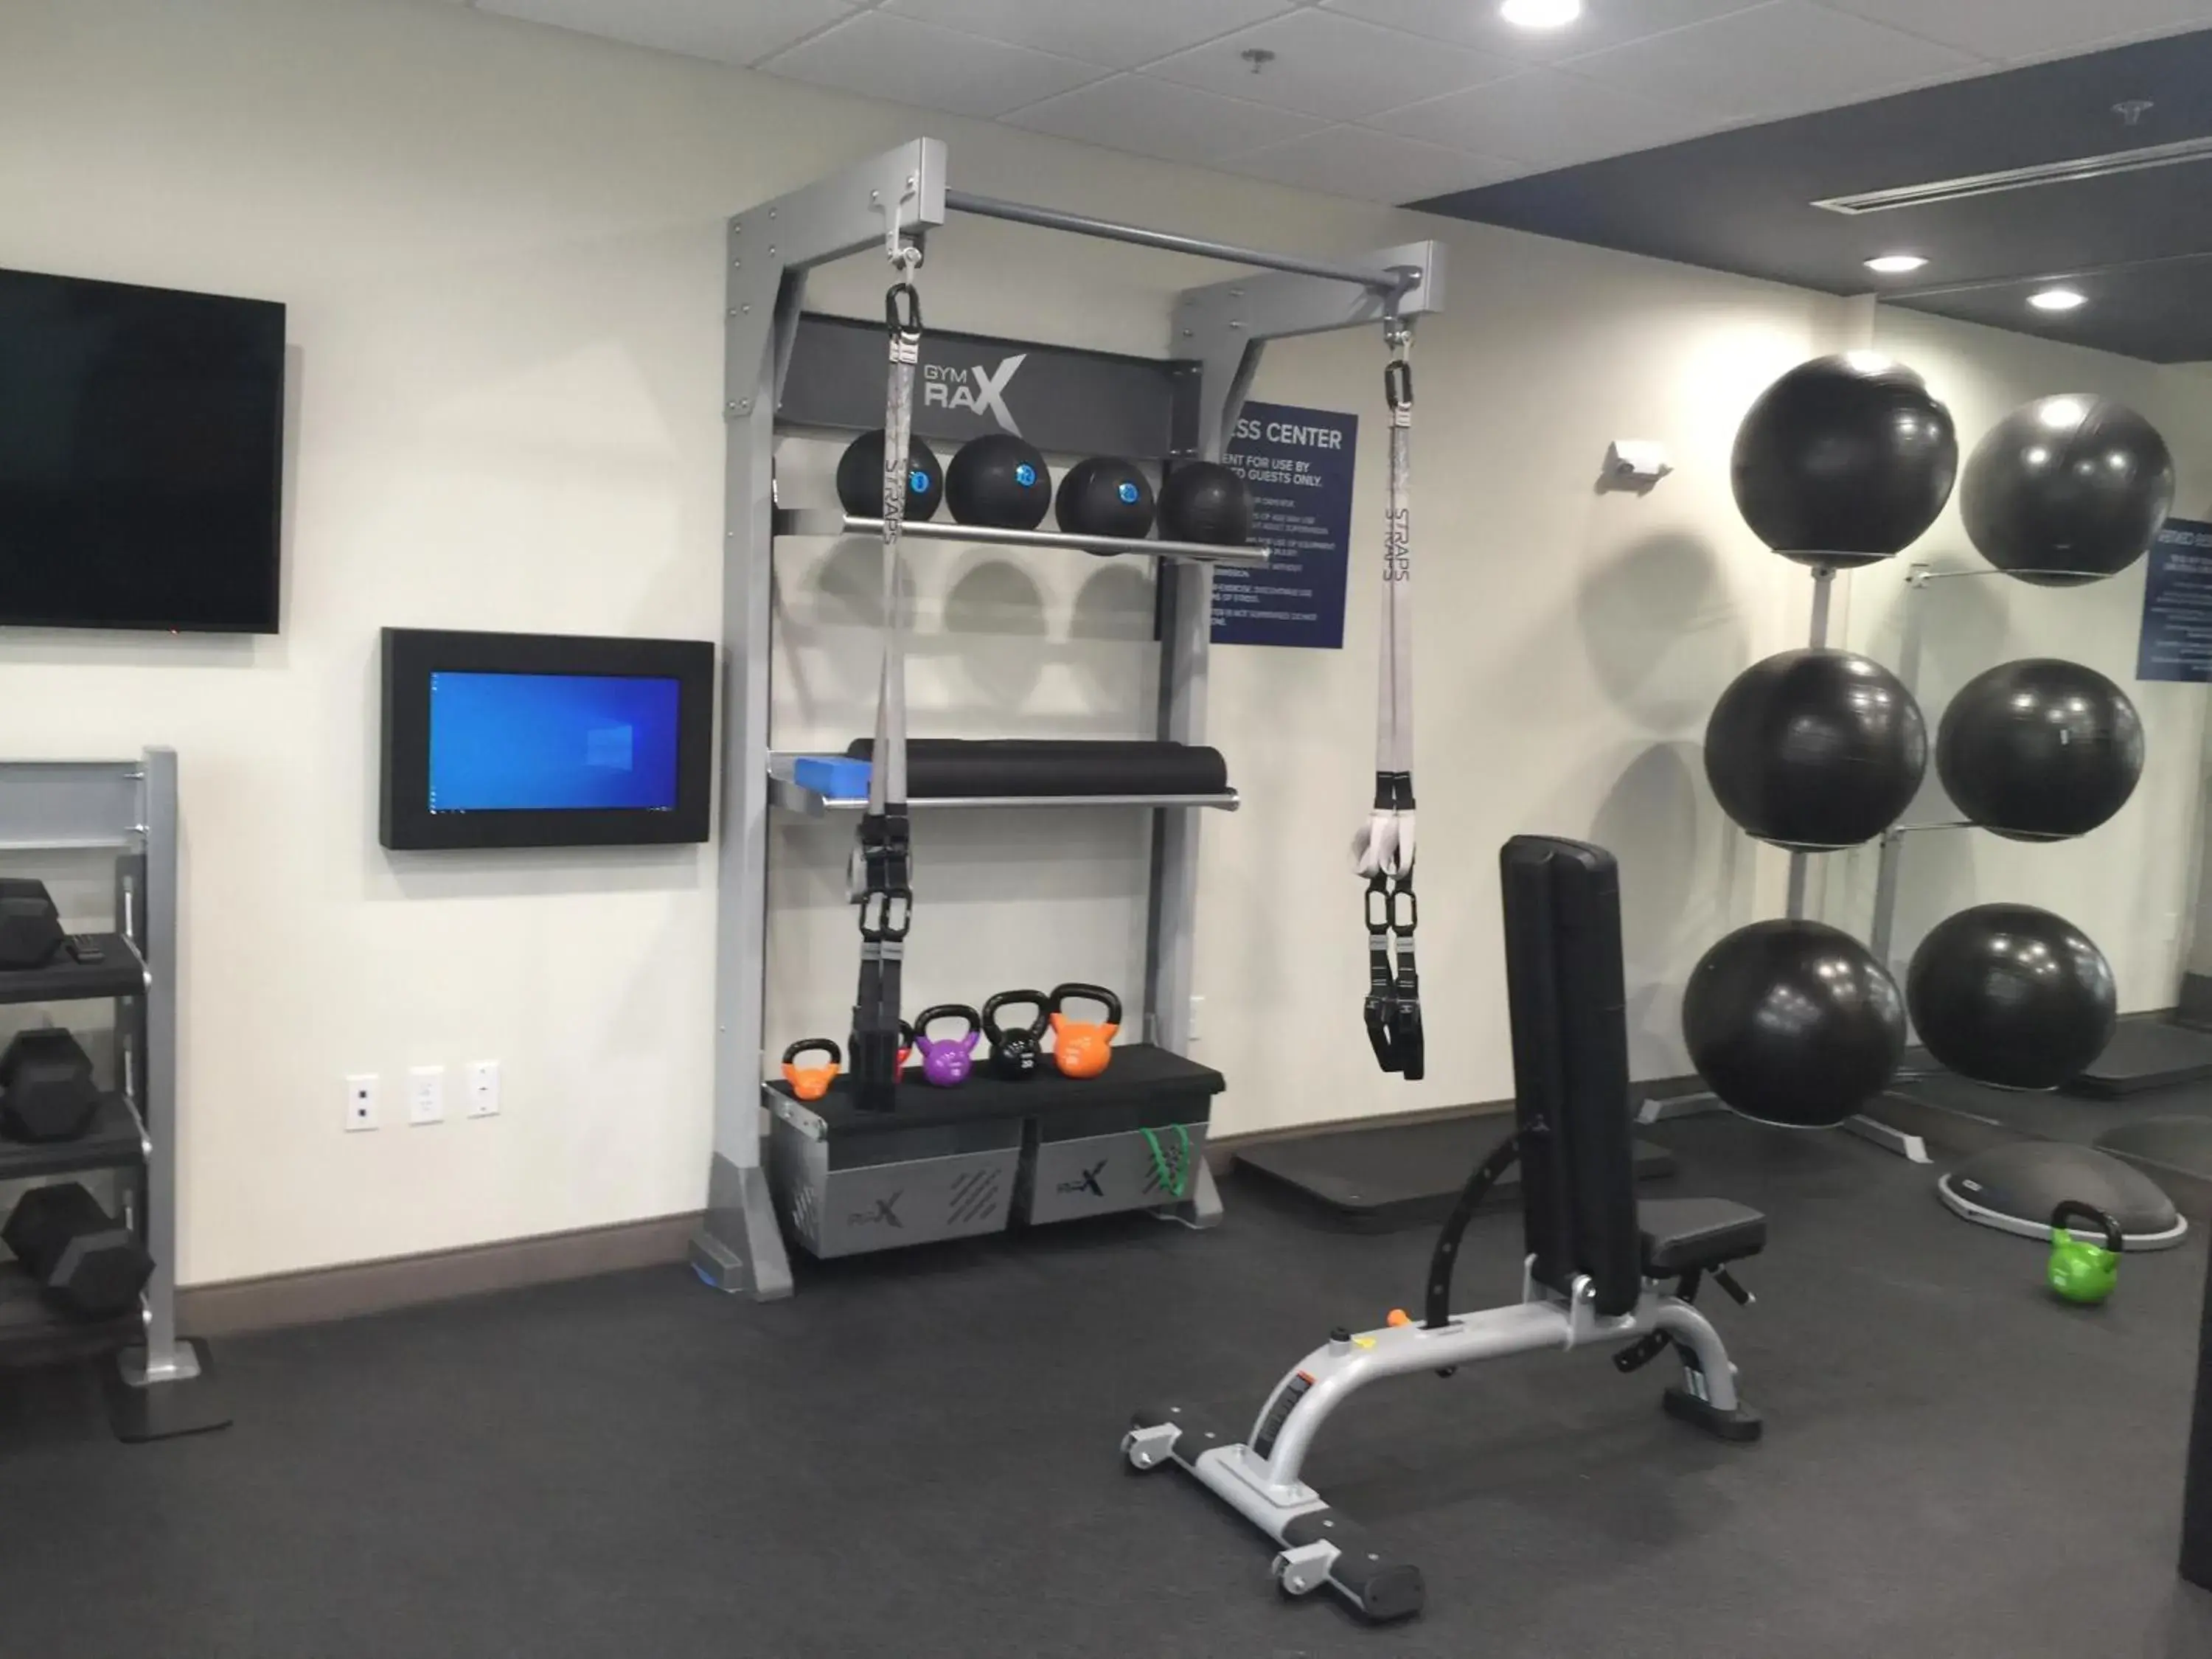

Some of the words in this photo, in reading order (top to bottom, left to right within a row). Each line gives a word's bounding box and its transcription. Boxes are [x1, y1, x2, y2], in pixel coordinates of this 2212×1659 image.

[924, 364, 967, 383] GYM
[924, 353, 1028, 439] RAX
[1231, 418, 1262, 440] SS
[1266, 422, 1343, 450] CENTER
[1246, 456, 1270, 468] FOR
[1271, 459, 1294, 471] USE
[1295, 461, 1312, 473] BY
[1248, 469, 1292, 484] GUESTS
[1293, 473, 1324, 487] ONLY.
[1394, 508, 1410, 582] STRAPS
